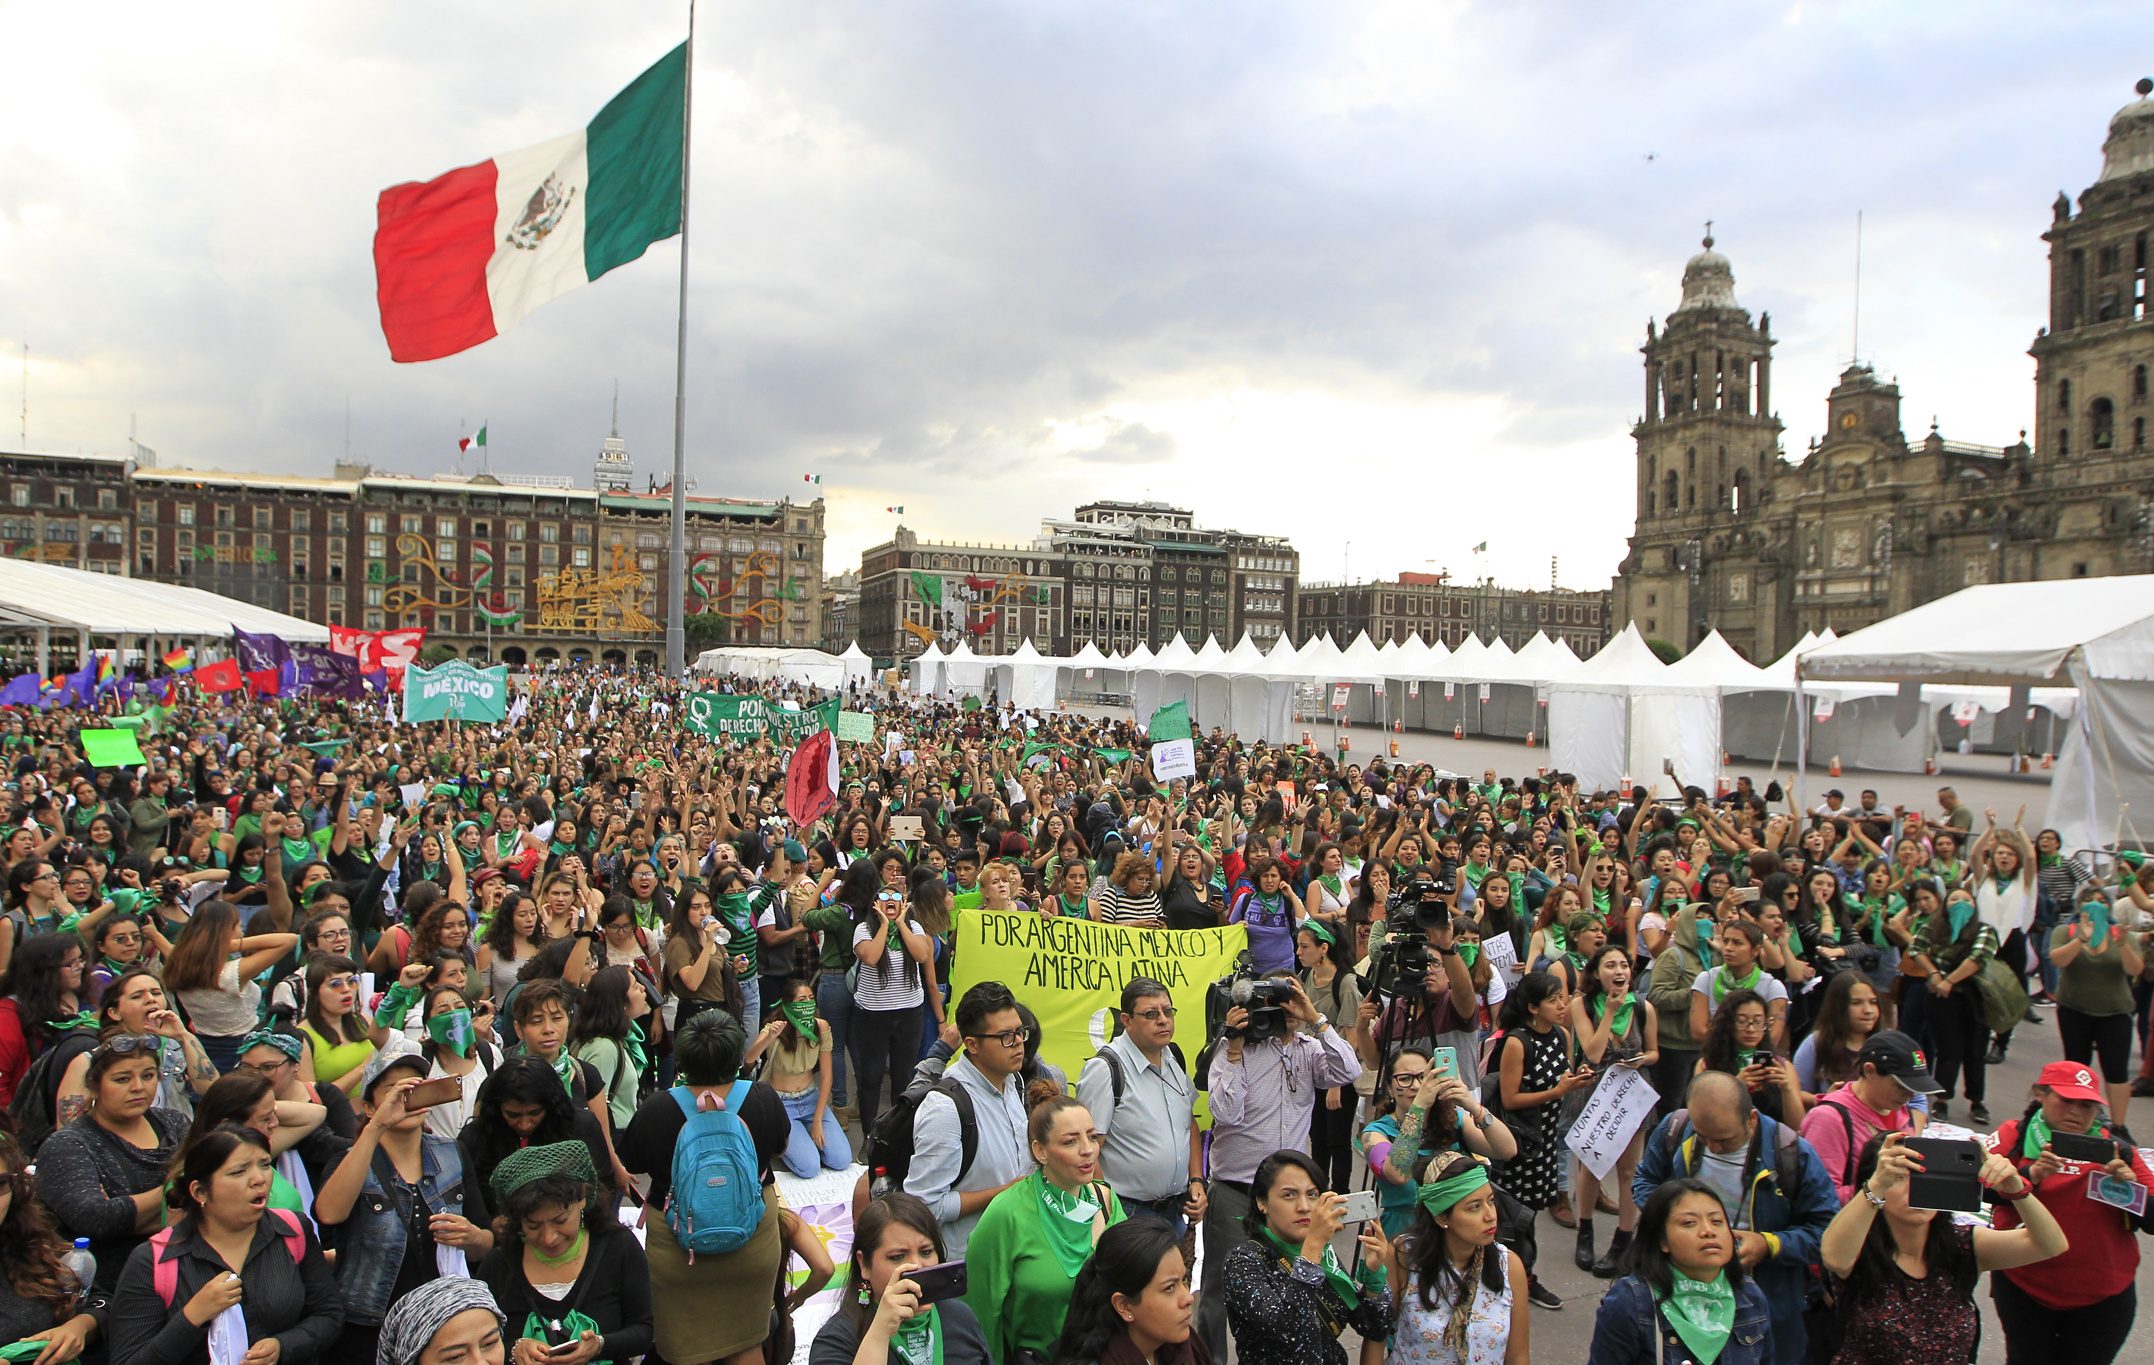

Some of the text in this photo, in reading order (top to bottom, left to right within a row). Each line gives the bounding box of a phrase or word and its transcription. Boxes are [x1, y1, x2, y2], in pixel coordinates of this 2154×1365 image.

[423, 675, 494, 699] MÉXICO
[720, 718, 769, 734] DERECHO
[738, 699, 766, 718] POR
[765, 706, 818, 728] NUESTRO
[981, 914, 1026, 947] POR
[1026, 917, 1136, 956] ARGENTINA
[1211, 928, 1224, 955] Y
[1024, 952, 1190, 992] AMERICA LATINA
[1572, 1071, 1618, 1139] JUNTAS POR
[1581, 1071, 1639, 1154] NUESTRO DERECHO
[1594, 1107, 1628, 1160] A DECIDIR
